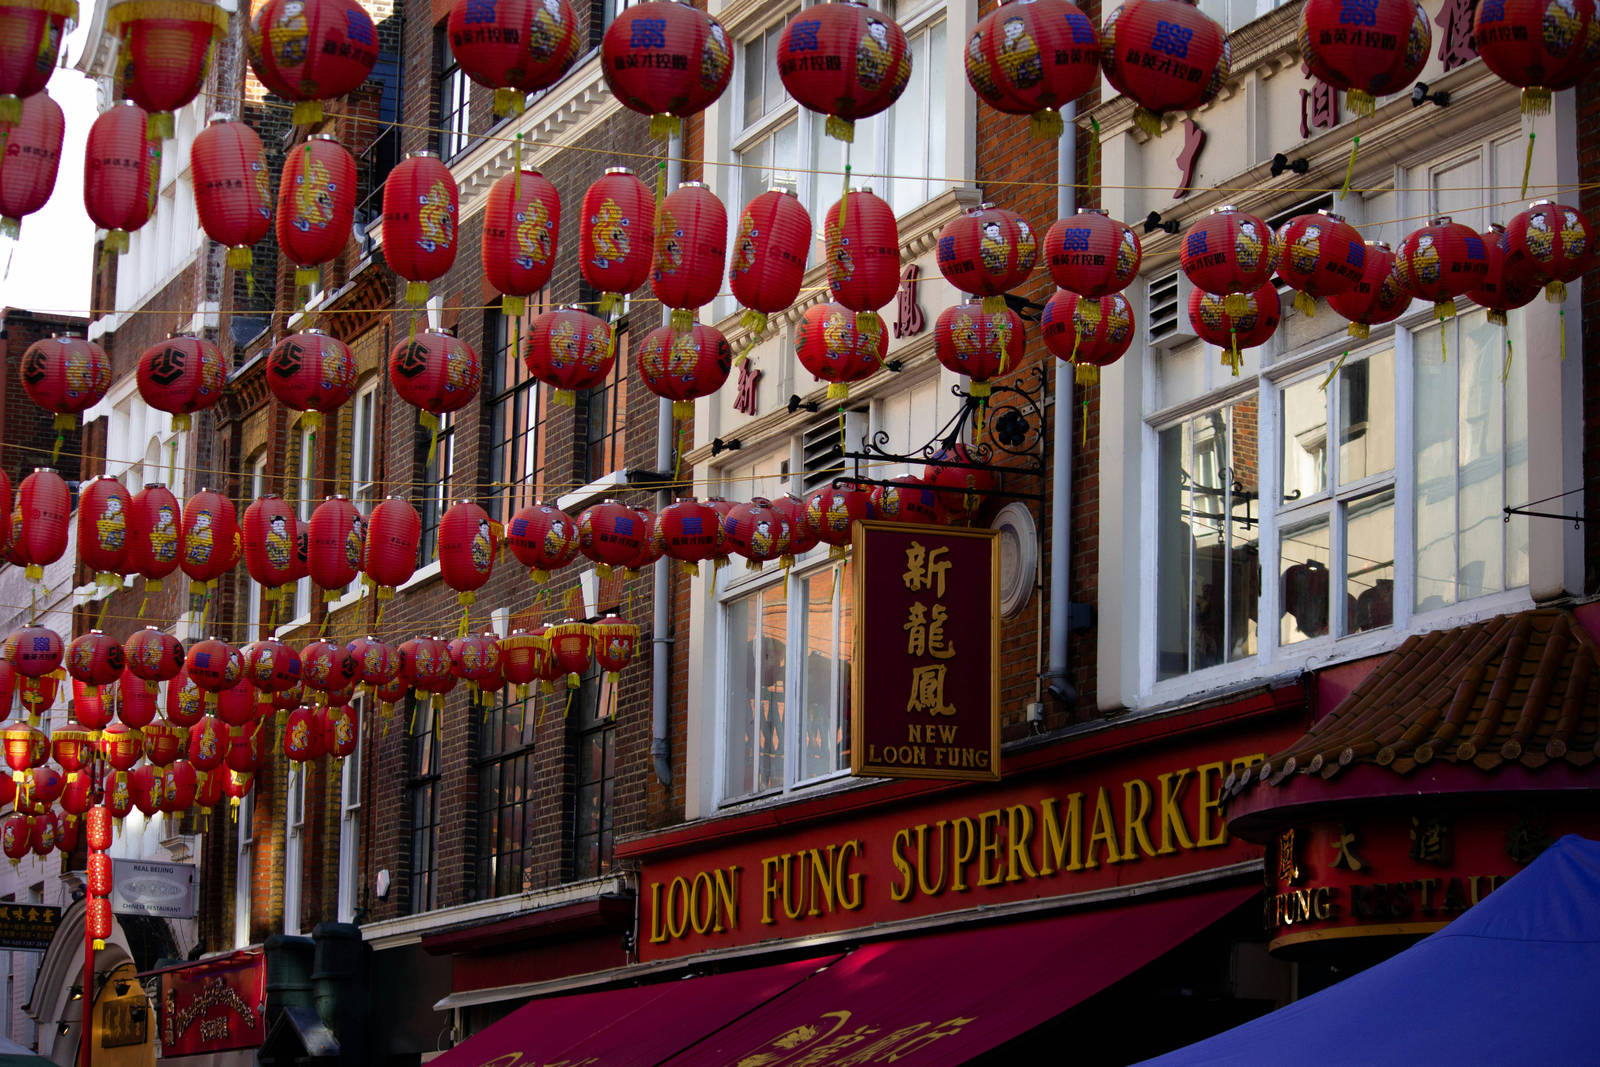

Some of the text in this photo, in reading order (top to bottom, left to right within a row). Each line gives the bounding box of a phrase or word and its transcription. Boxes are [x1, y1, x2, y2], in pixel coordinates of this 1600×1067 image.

[902, 540, 957, 717] 新龍鳳
[908, 724, 959, 744] NEW
[868, 743, 989, 768] LOON FUNG
[133, 865, 174, 874] REAL BEIJING
[649, 864, 739, 944] LOON
[761, 838, 864, 925] FUNG
[1274, 874, 1512, 927] FUNG RESTAU
[122, 903, 182, 913] CHINESE RESTAURANT
